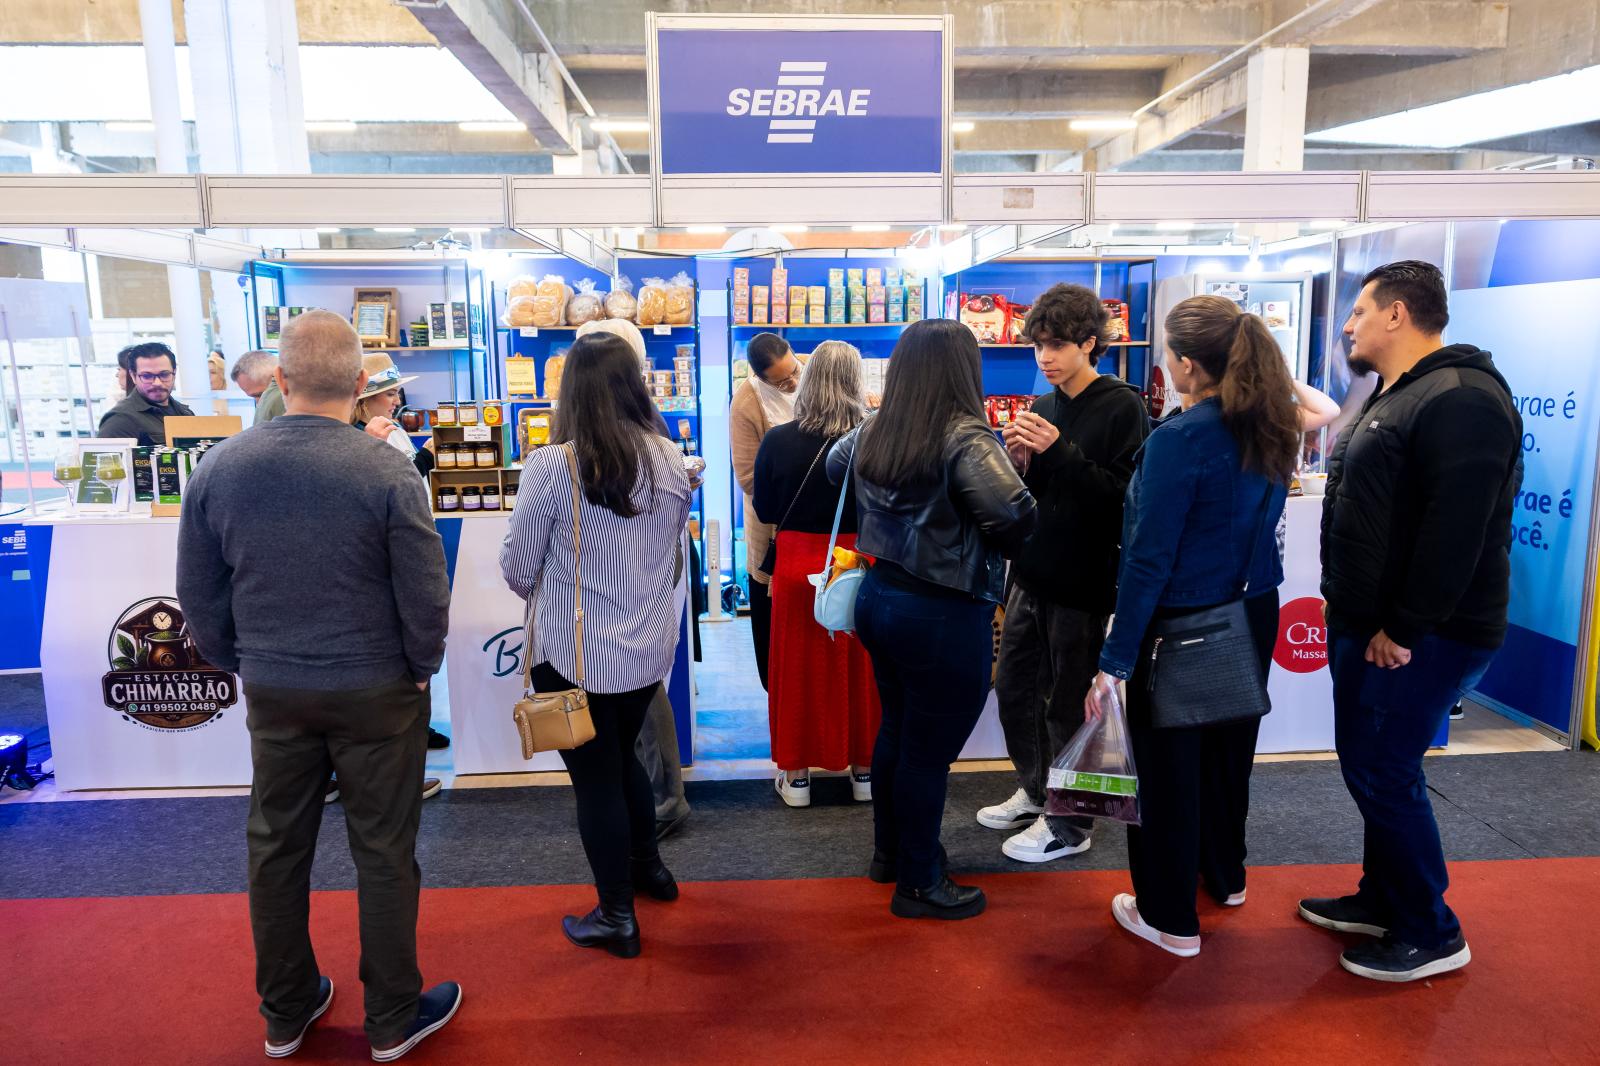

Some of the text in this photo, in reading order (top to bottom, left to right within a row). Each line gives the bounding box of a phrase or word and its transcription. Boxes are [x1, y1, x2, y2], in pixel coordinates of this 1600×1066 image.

[726, 88, 871, 116] SEBRAE
[1562, 390, 1576, 419] é
[1558, 488, 1573, 518] é
[1292, 648, 1328, 659] Massa
[134, 672, 200, 683] ESTAÇÃO
[110, 680, 230, 703] CHIMARRÃO
[139, 702, 217, 712] 41 99502 0489
